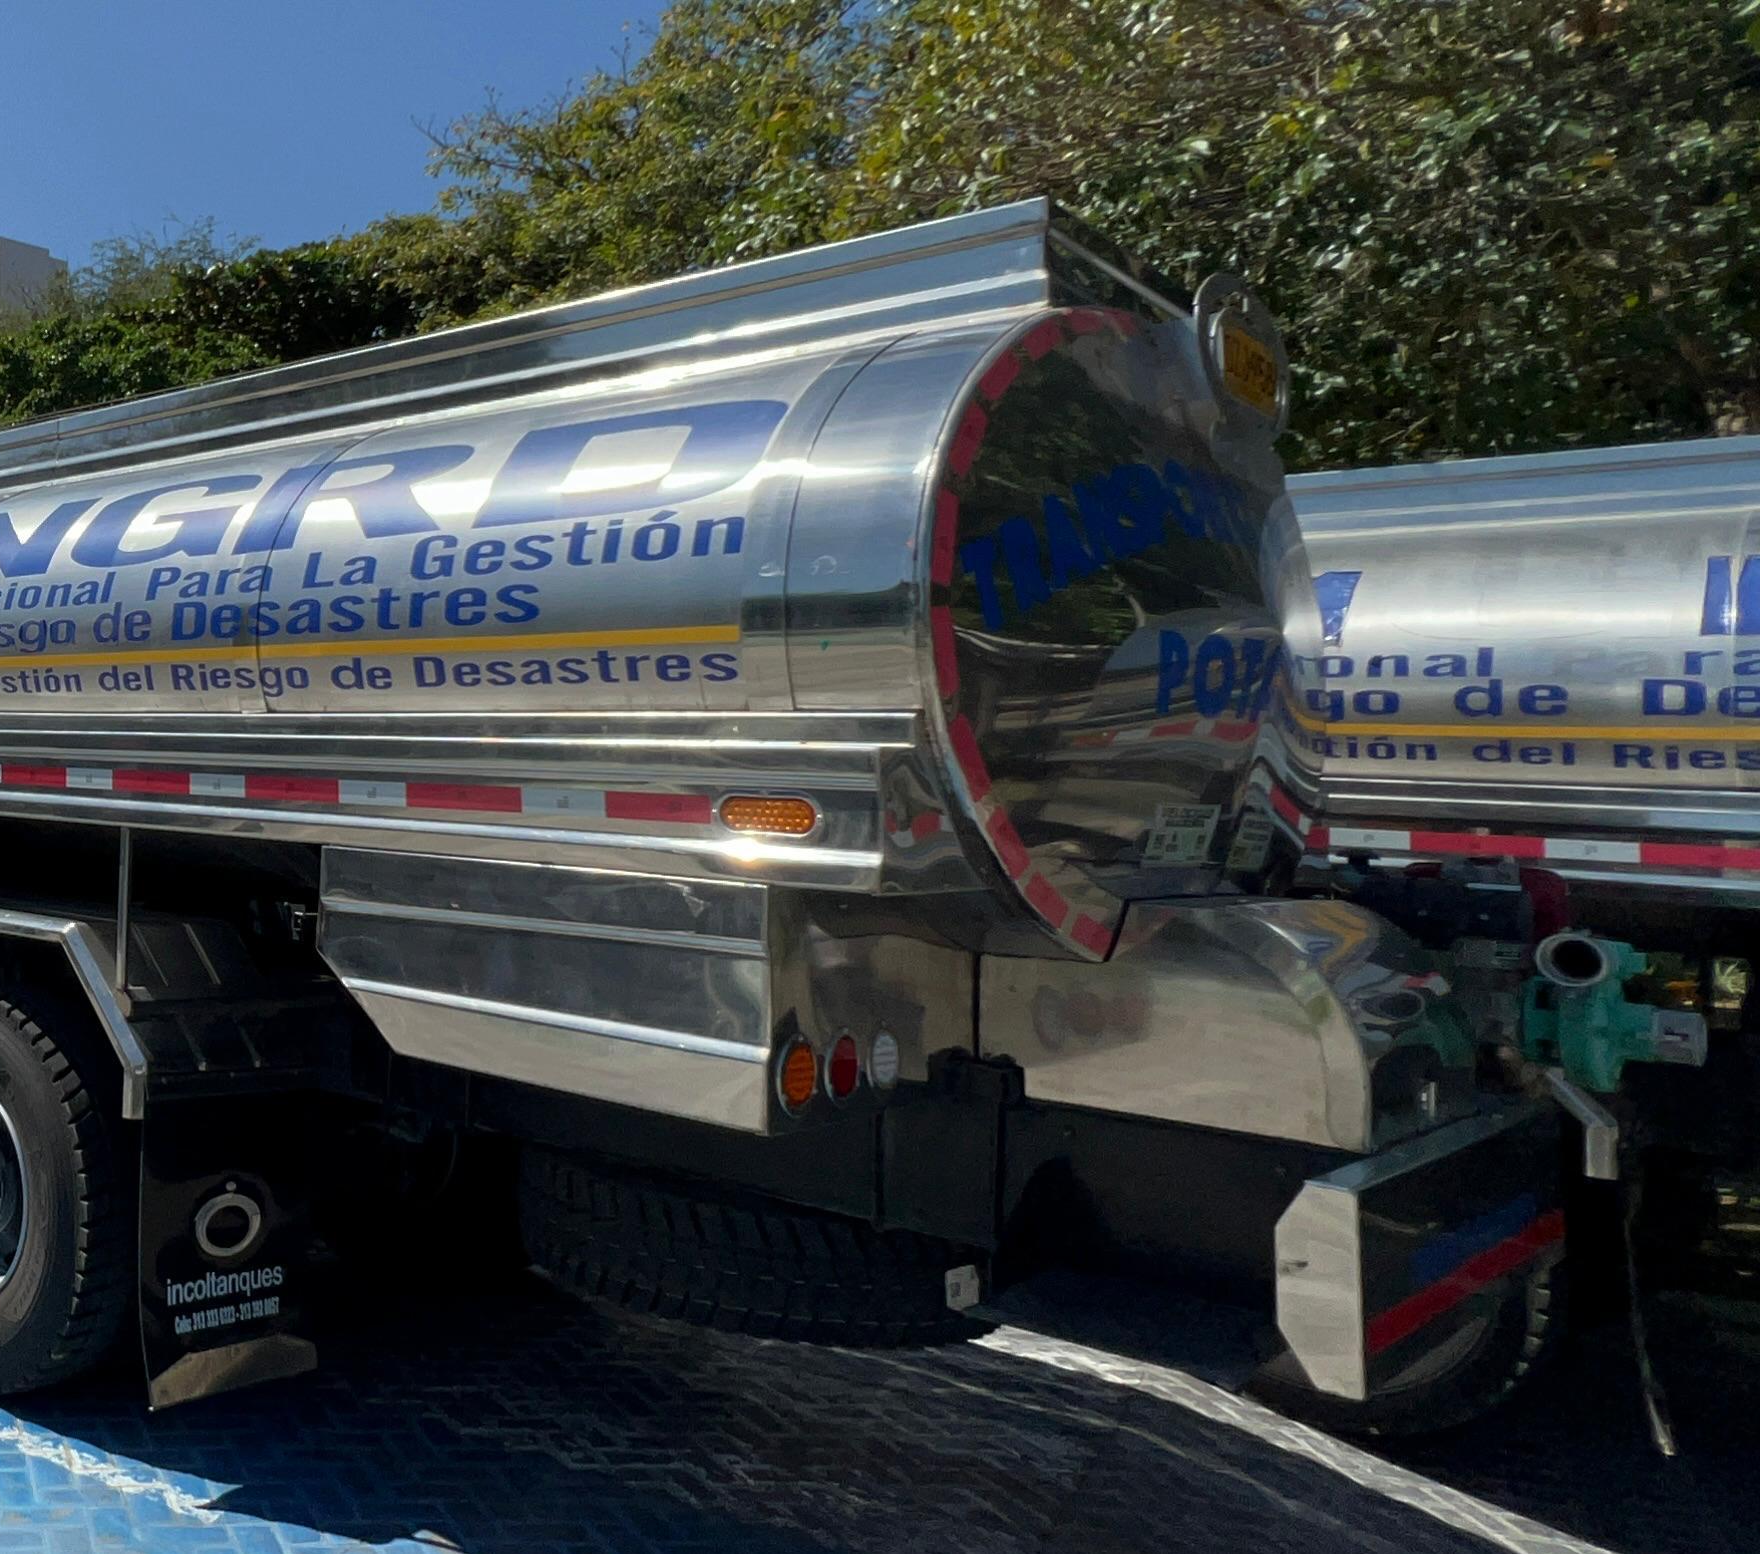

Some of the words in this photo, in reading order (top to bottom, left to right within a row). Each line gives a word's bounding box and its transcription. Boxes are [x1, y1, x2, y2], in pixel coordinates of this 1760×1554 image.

[146, 566, 274, 601] Para
[302, 552, 377, 589] La
[410, 510, 746, 581] Gestión
[93, 602, 152, 642] de
[171, 583, 540, 642] Desastres
[98, 664, 154, 692] del
[171, 662, 310, 698] Riesgo
[331, 656, 393, 690] de
[411, 650, 738, 688] Desastres
[1318, 646, 1494, 678] onal
[1453, 679, 1569, 717] de
[1642, 679, 1760, 719] De
[1320, 735, 1438, 761] tión
[1472, 740, 1576, 766] del
[1612, 743, 1760, 771] Ries
[166, 1265, 283, 1307] incoltanques
